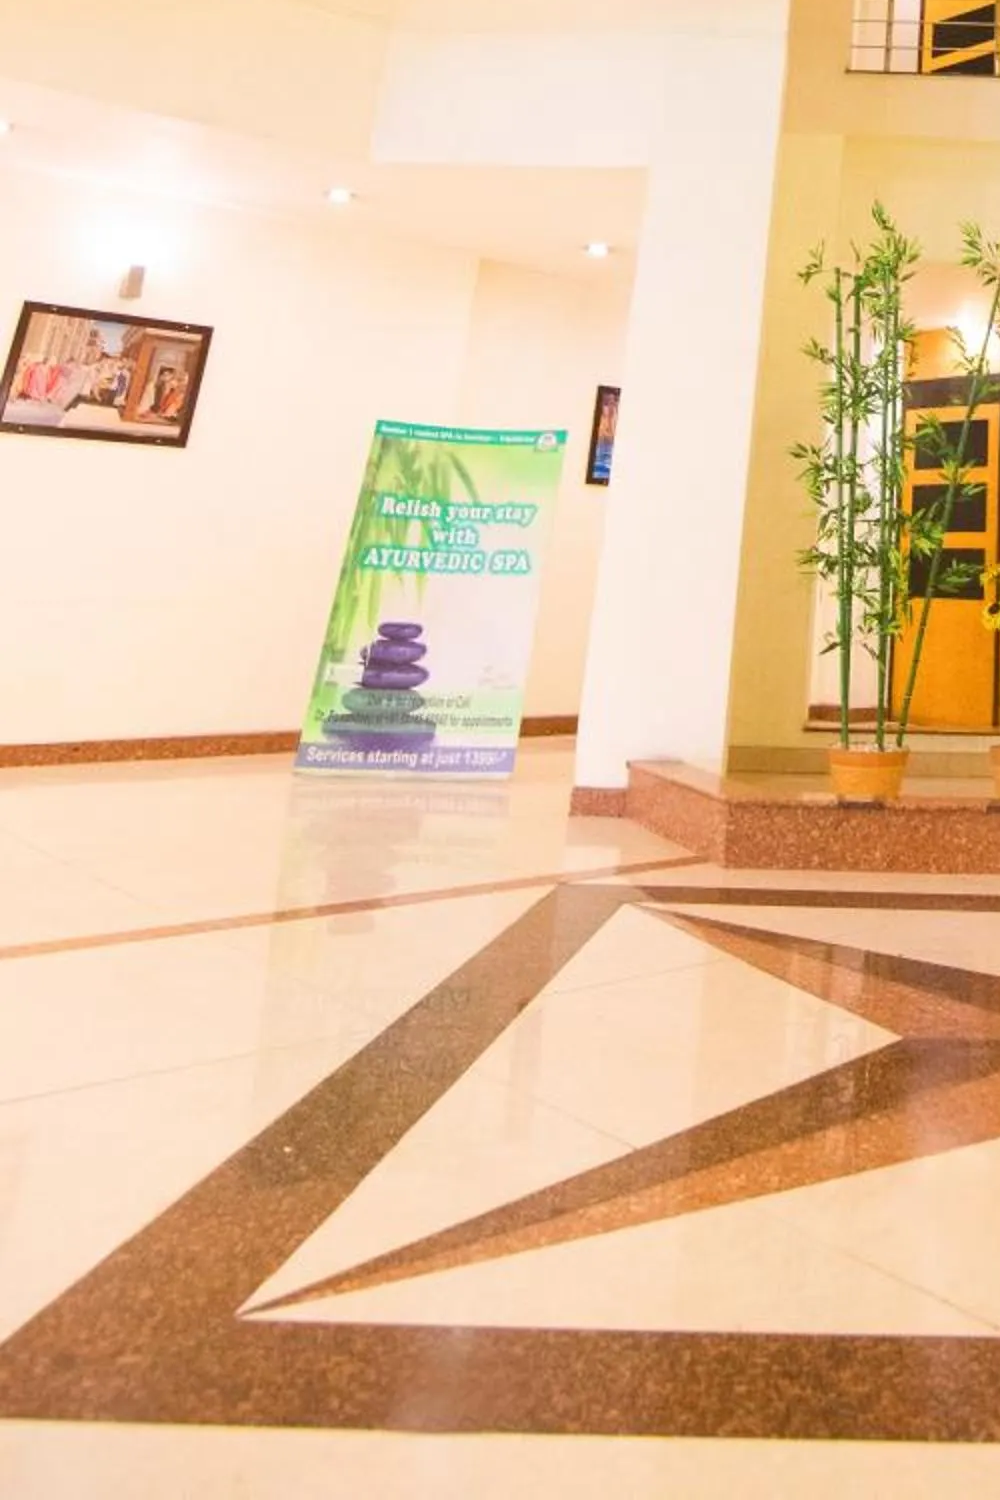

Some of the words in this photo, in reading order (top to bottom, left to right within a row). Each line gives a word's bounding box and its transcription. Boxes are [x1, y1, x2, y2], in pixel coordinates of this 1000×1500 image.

[382, 497, 441, 517] Relish
[446, 506, 492, 521] your
[495, 506, 535, 524] stay
[432, 526, 476, 545] with
[364, 547, 484, 569] AYURVEDIC
[491, 553, 529, 571] SPA
[306, 745, 363, 763] Services
[367, 750, 417, 767] starting
[420, 751, 433, 764] at
[434, 750, 461, 768] just
